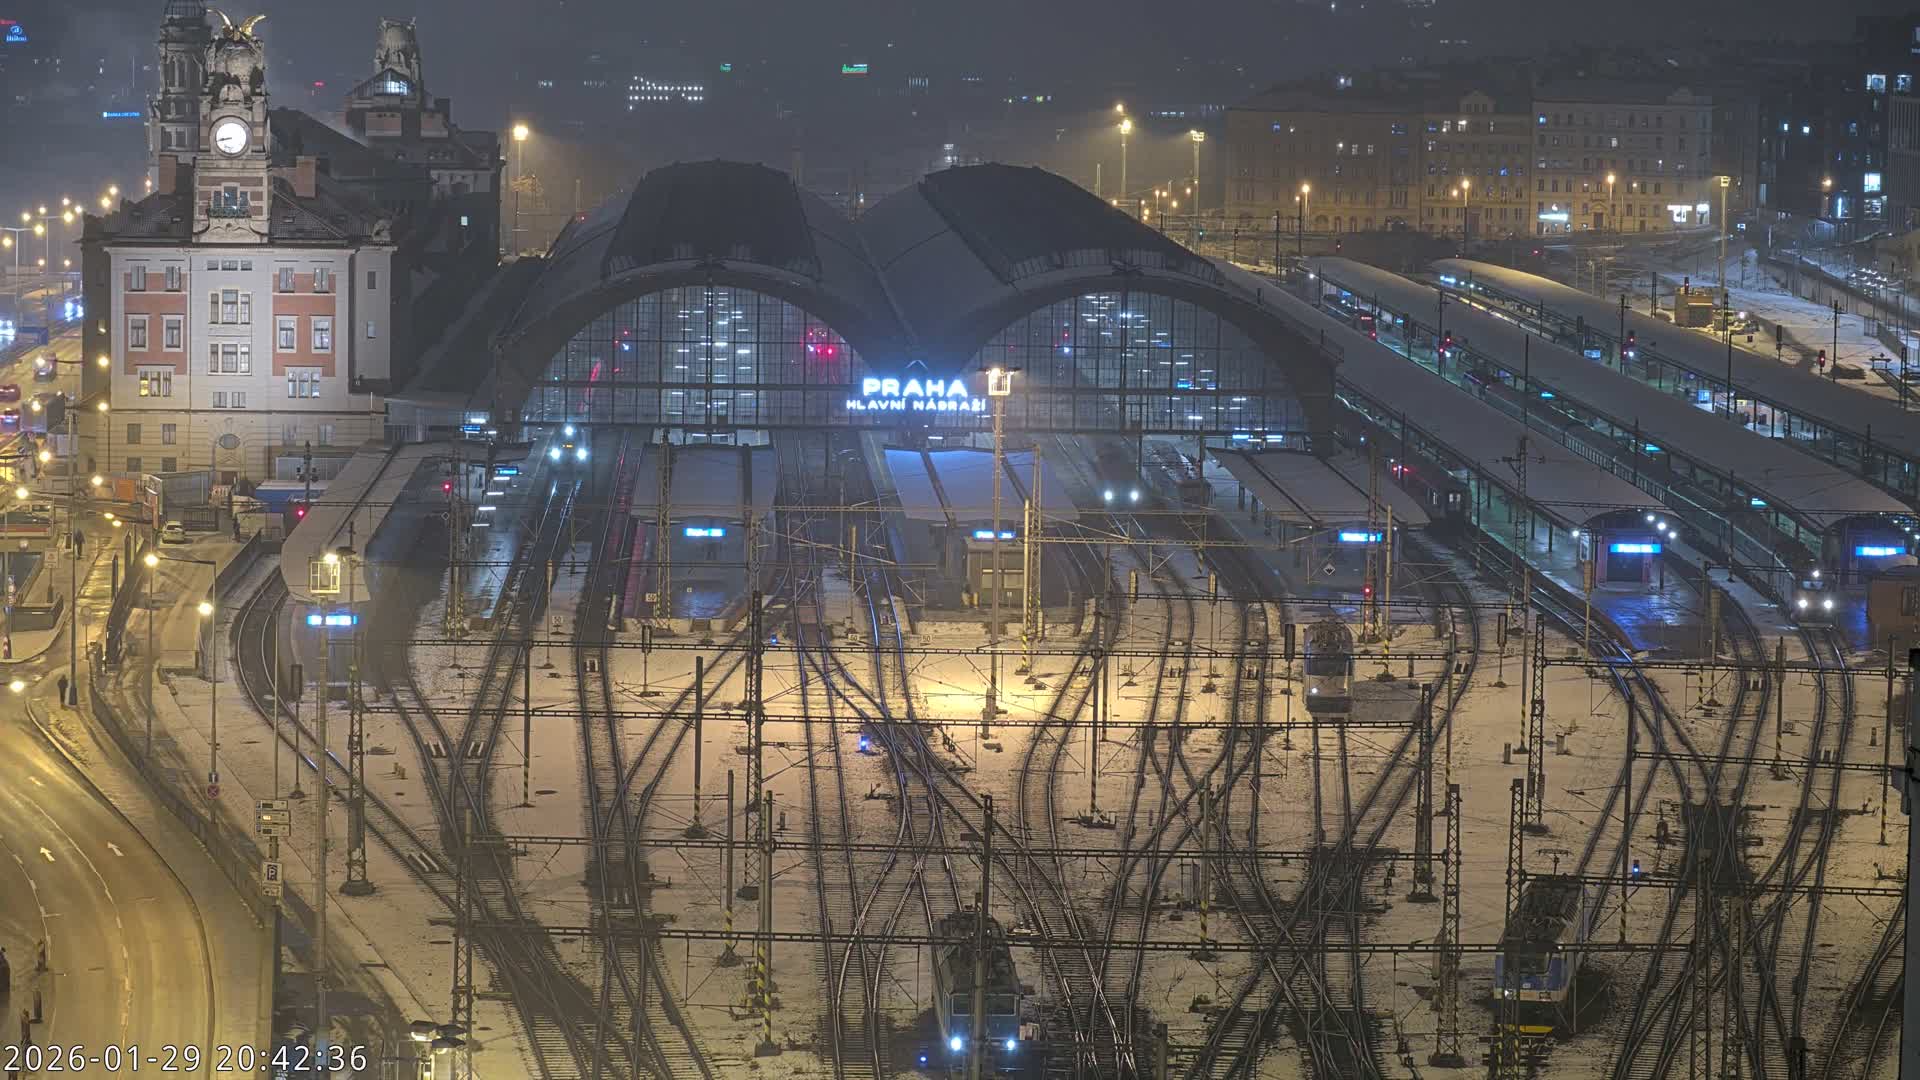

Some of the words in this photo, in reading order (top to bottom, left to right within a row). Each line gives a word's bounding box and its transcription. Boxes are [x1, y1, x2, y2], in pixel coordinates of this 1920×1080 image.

[6, 34, 27, 42] Hilton
[863, 378, 968, 397] PRAHA
[846, 398, 906, 411] HLAVNÍ
[913, 397, 986, 412] NÁDRAŽÍ
[1506, 647, 1515, 655] 50
